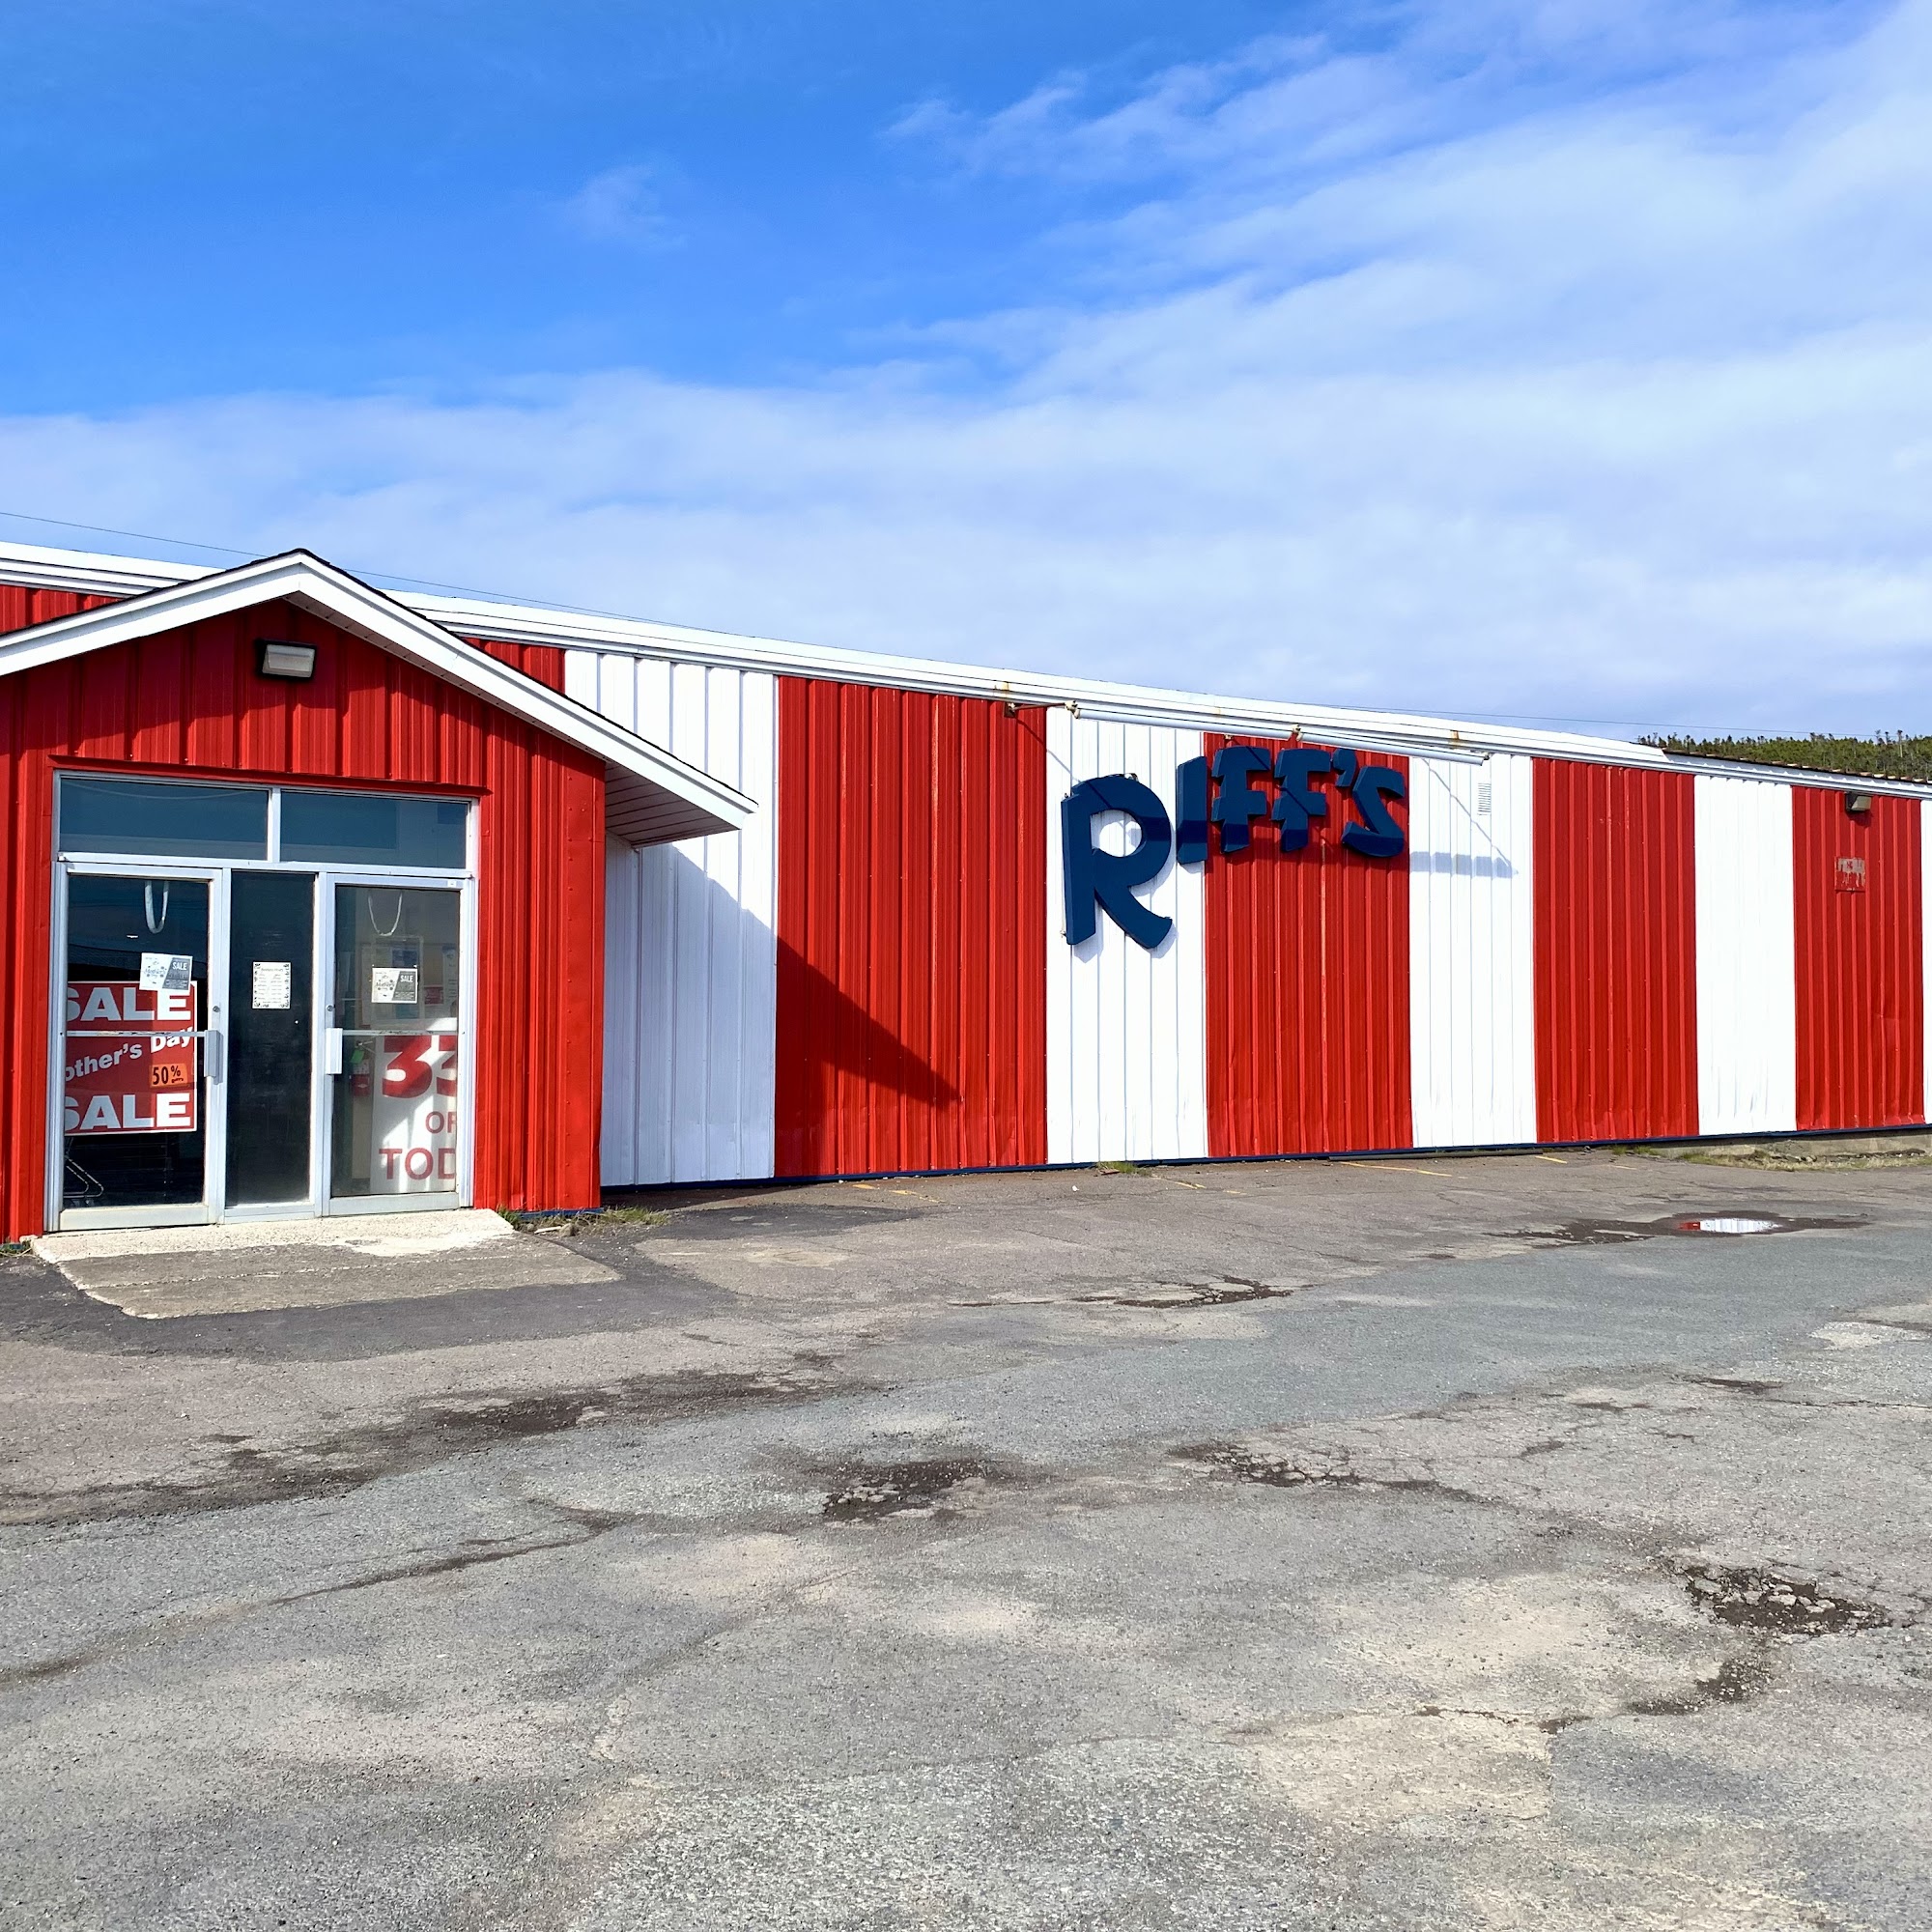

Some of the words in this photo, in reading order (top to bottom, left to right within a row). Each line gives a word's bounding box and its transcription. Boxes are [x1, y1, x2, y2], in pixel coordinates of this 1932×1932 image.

[1061, 746, 1405, 950] RIFF'S
[172, 961, 187, 971] SALE
[400, 975, 413, 983] SALE
[151, 1027, 193, 1053] Day
[153, 1065, 182, 1085] 50%
